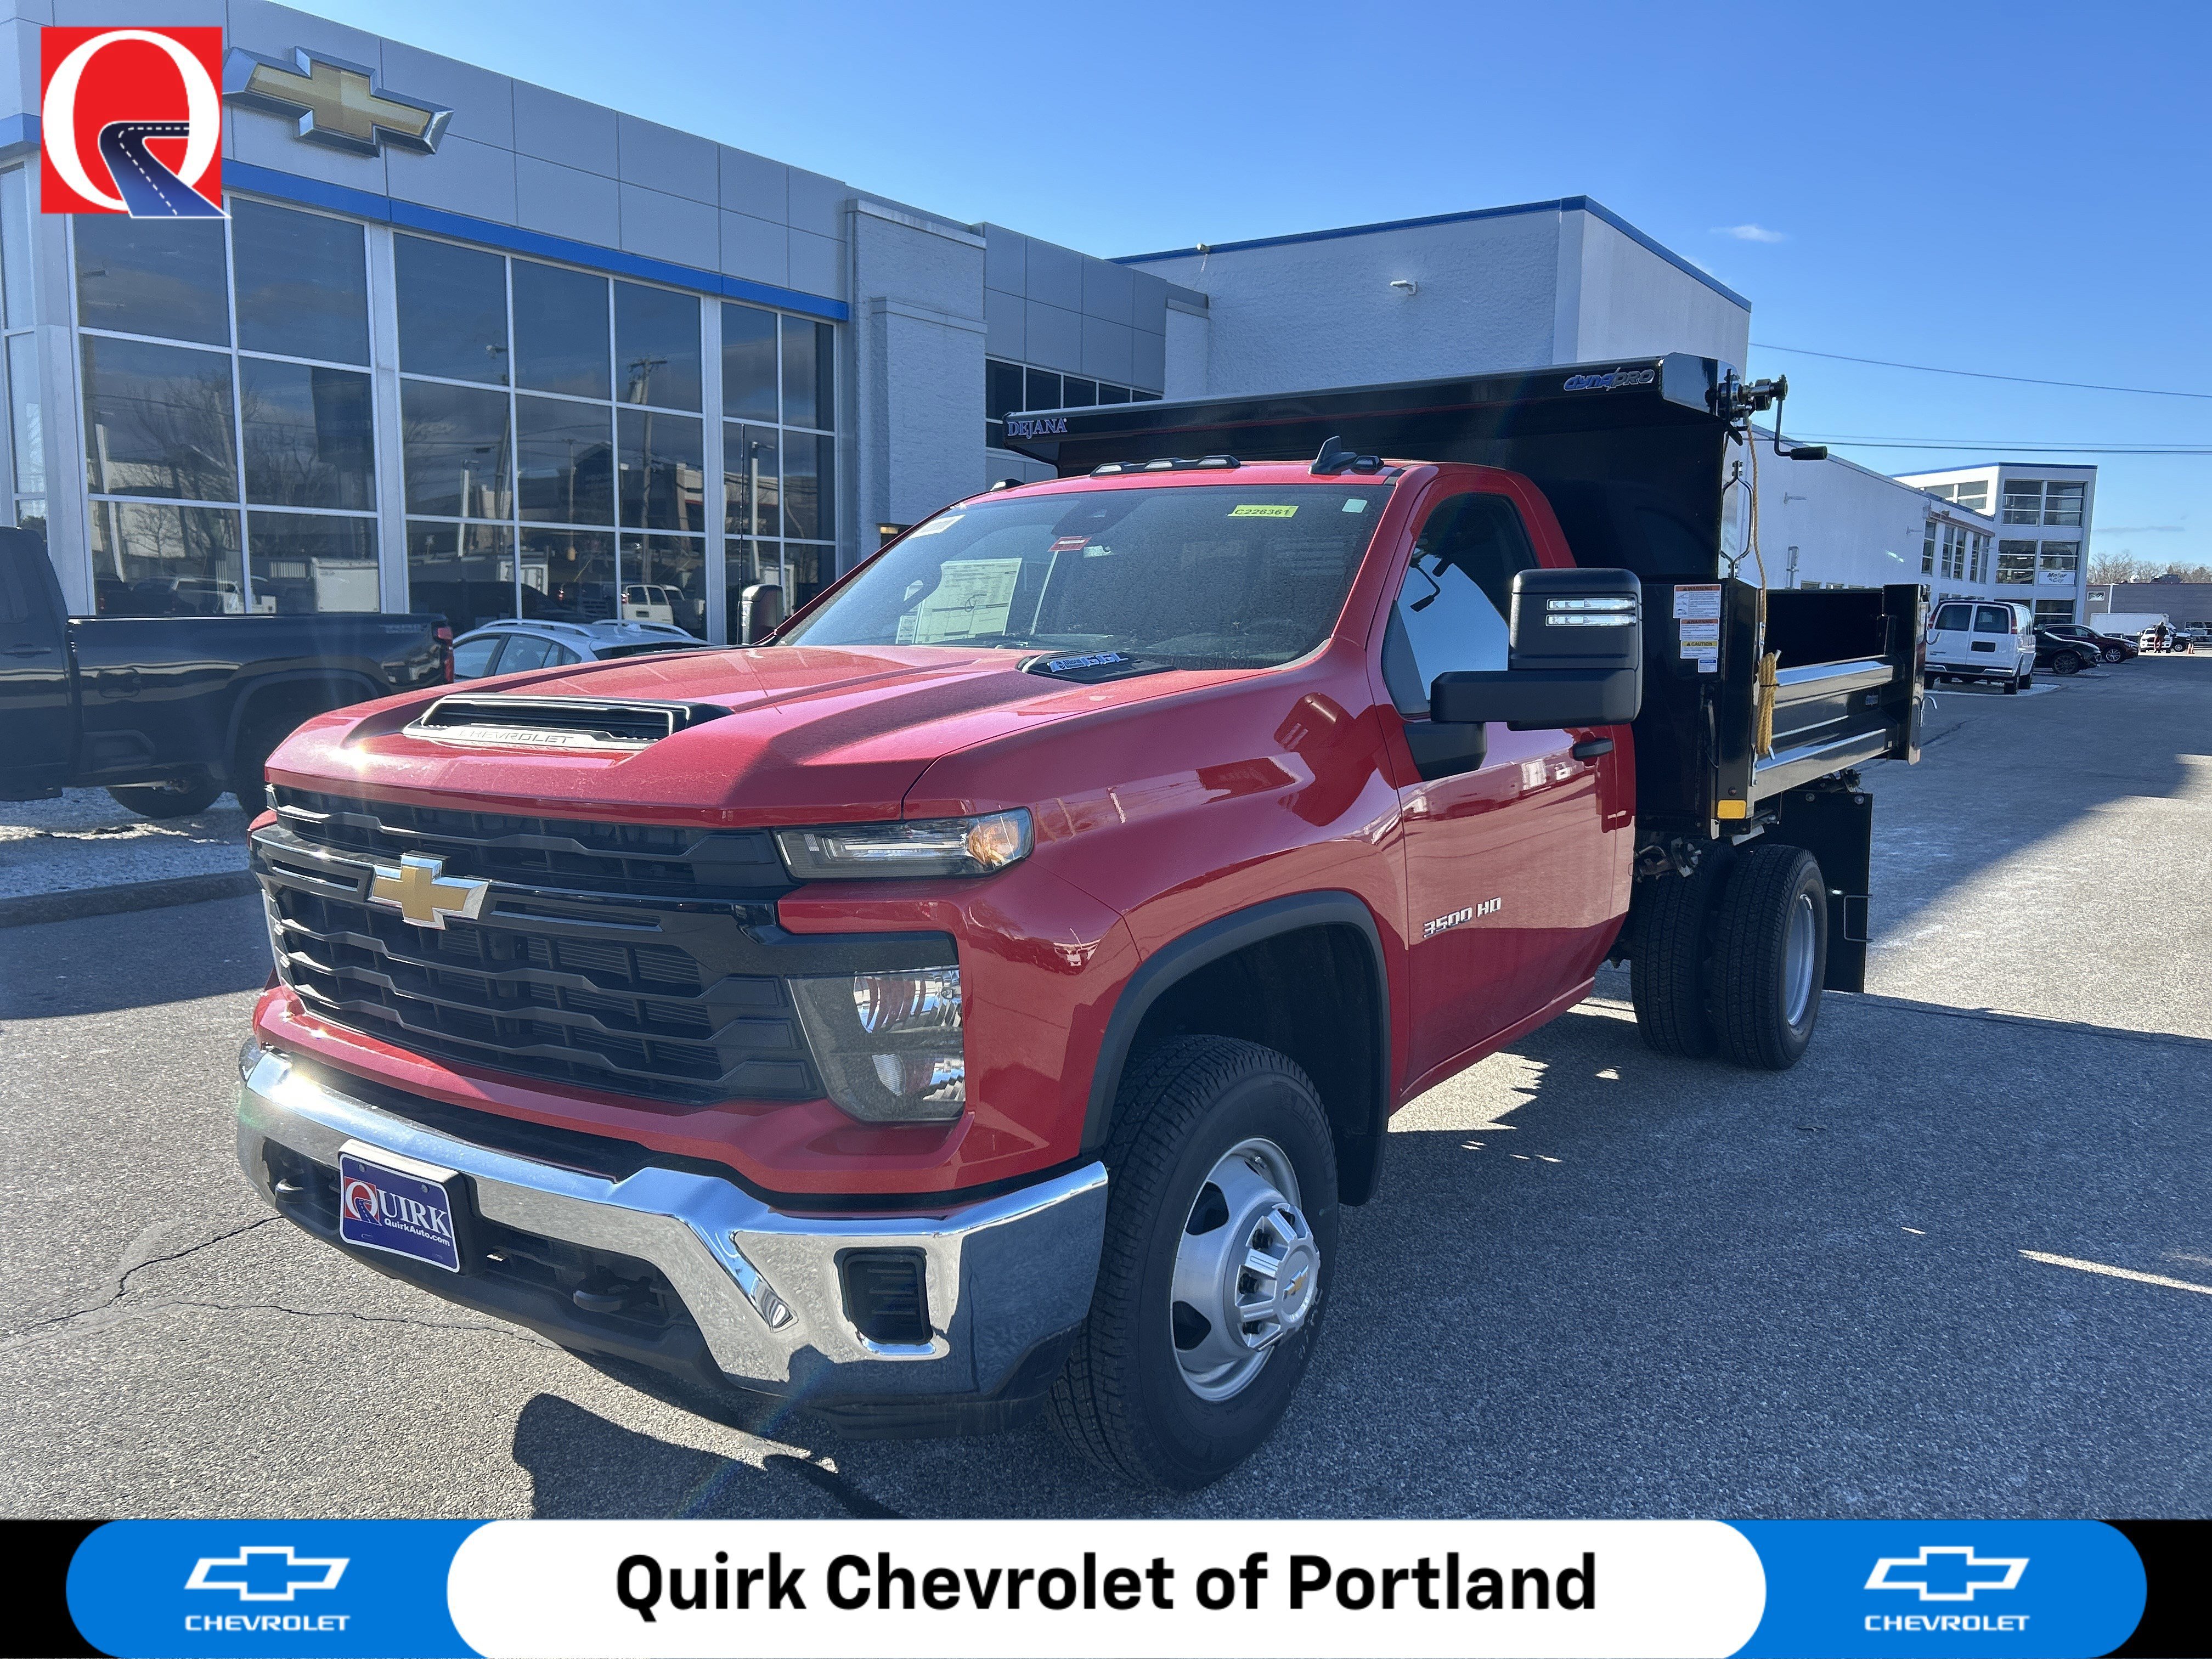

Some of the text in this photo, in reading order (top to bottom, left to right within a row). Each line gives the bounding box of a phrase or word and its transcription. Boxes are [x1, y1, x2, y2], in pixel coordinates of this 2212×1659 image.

[1007, 418, 1068, 439] DEJANA
[459, 730, 574, 744] CHEVROLET
[1424, 897, 1502, 938] 3500 HD
[345, 1178, 452, 1238] QUIRK
[384, 1217, 450, 1247] QuirkAuto.com
